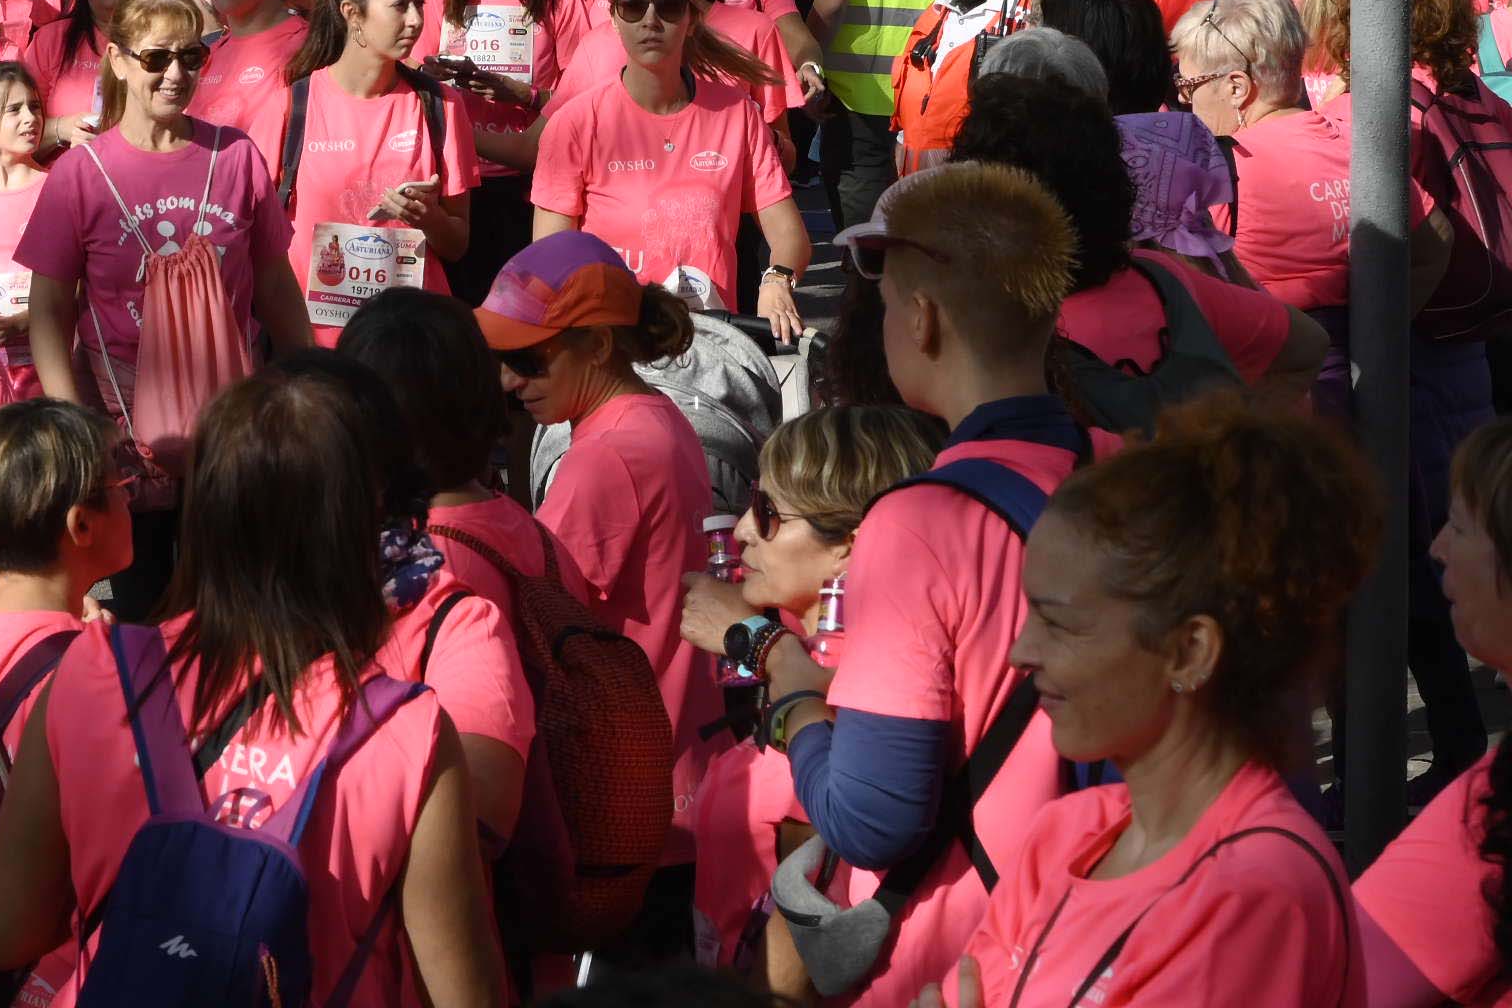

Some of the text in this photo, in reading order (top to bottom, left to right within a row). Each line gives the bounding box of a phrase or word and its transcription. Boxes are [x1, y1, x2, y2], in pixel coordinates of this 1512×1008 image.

[470, 39, 500, 51] 016
[308, 139, 356, 152] OYSHO
[607, 159, 655, 173] OYSHO
[349, 240, 393, 255] ASTURIANA
[348, 266, 387, 283] 016
[320, 293, 362, 306] CARRERA DE
[314, 306, 351, 320] OYSHO
